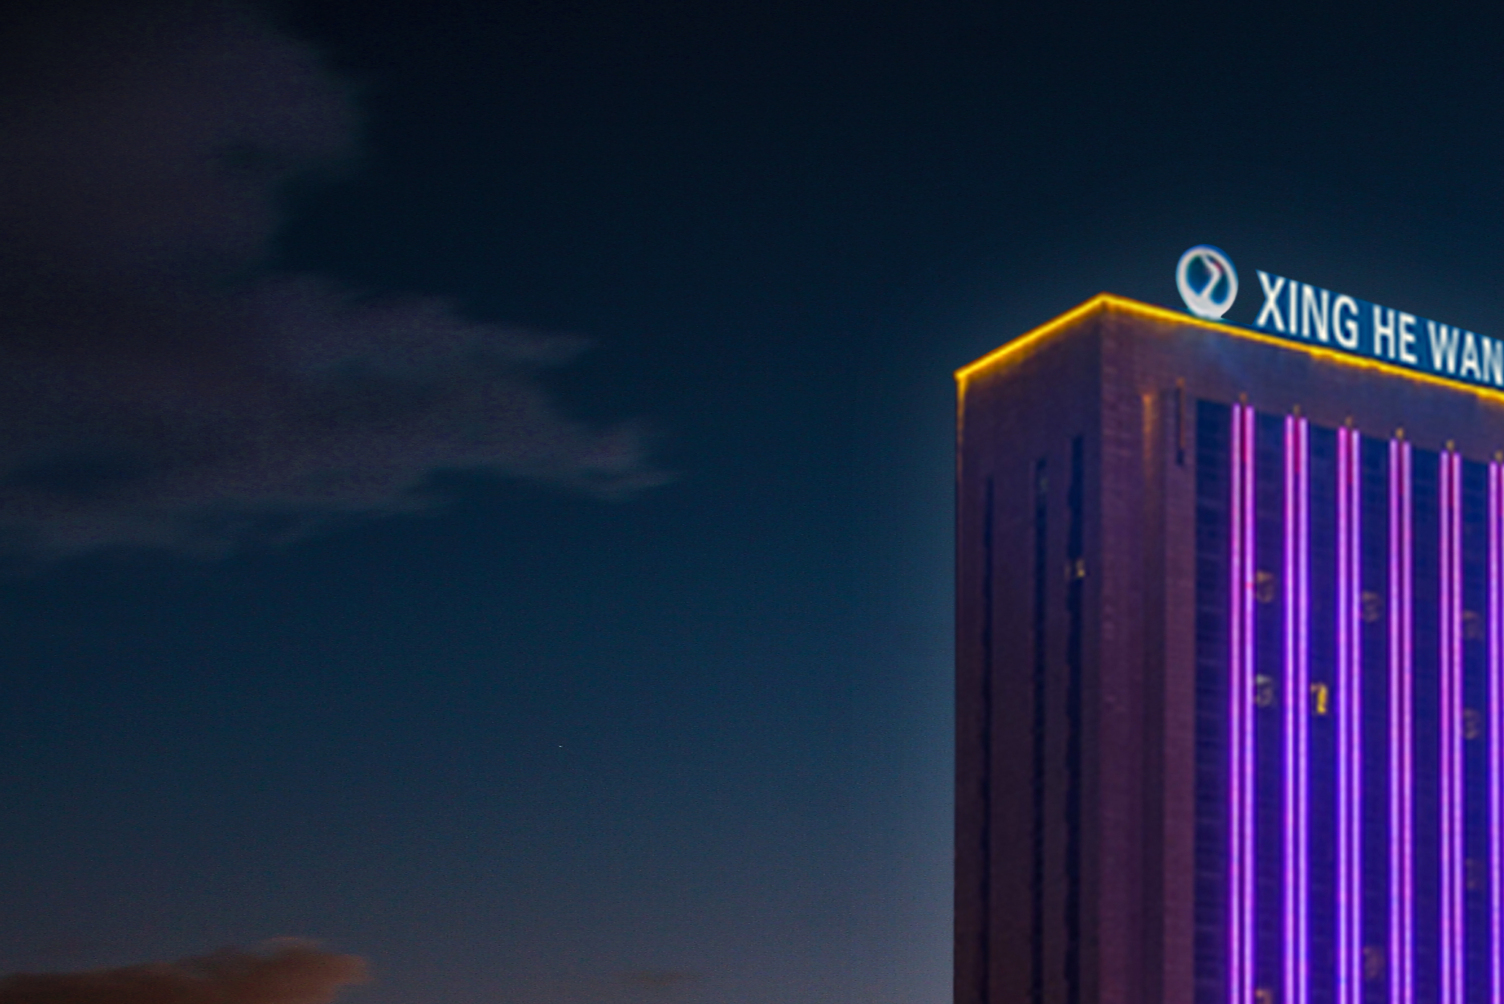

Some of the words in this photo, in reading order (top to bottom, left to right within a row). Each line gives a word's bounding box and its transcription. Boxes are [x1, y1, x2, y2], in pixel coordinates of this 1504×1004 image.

[1255, 269, 1359, 349] XING
[1372, 303, 1418, 365] HE
[1427, 319, 1504, 387] WAN
